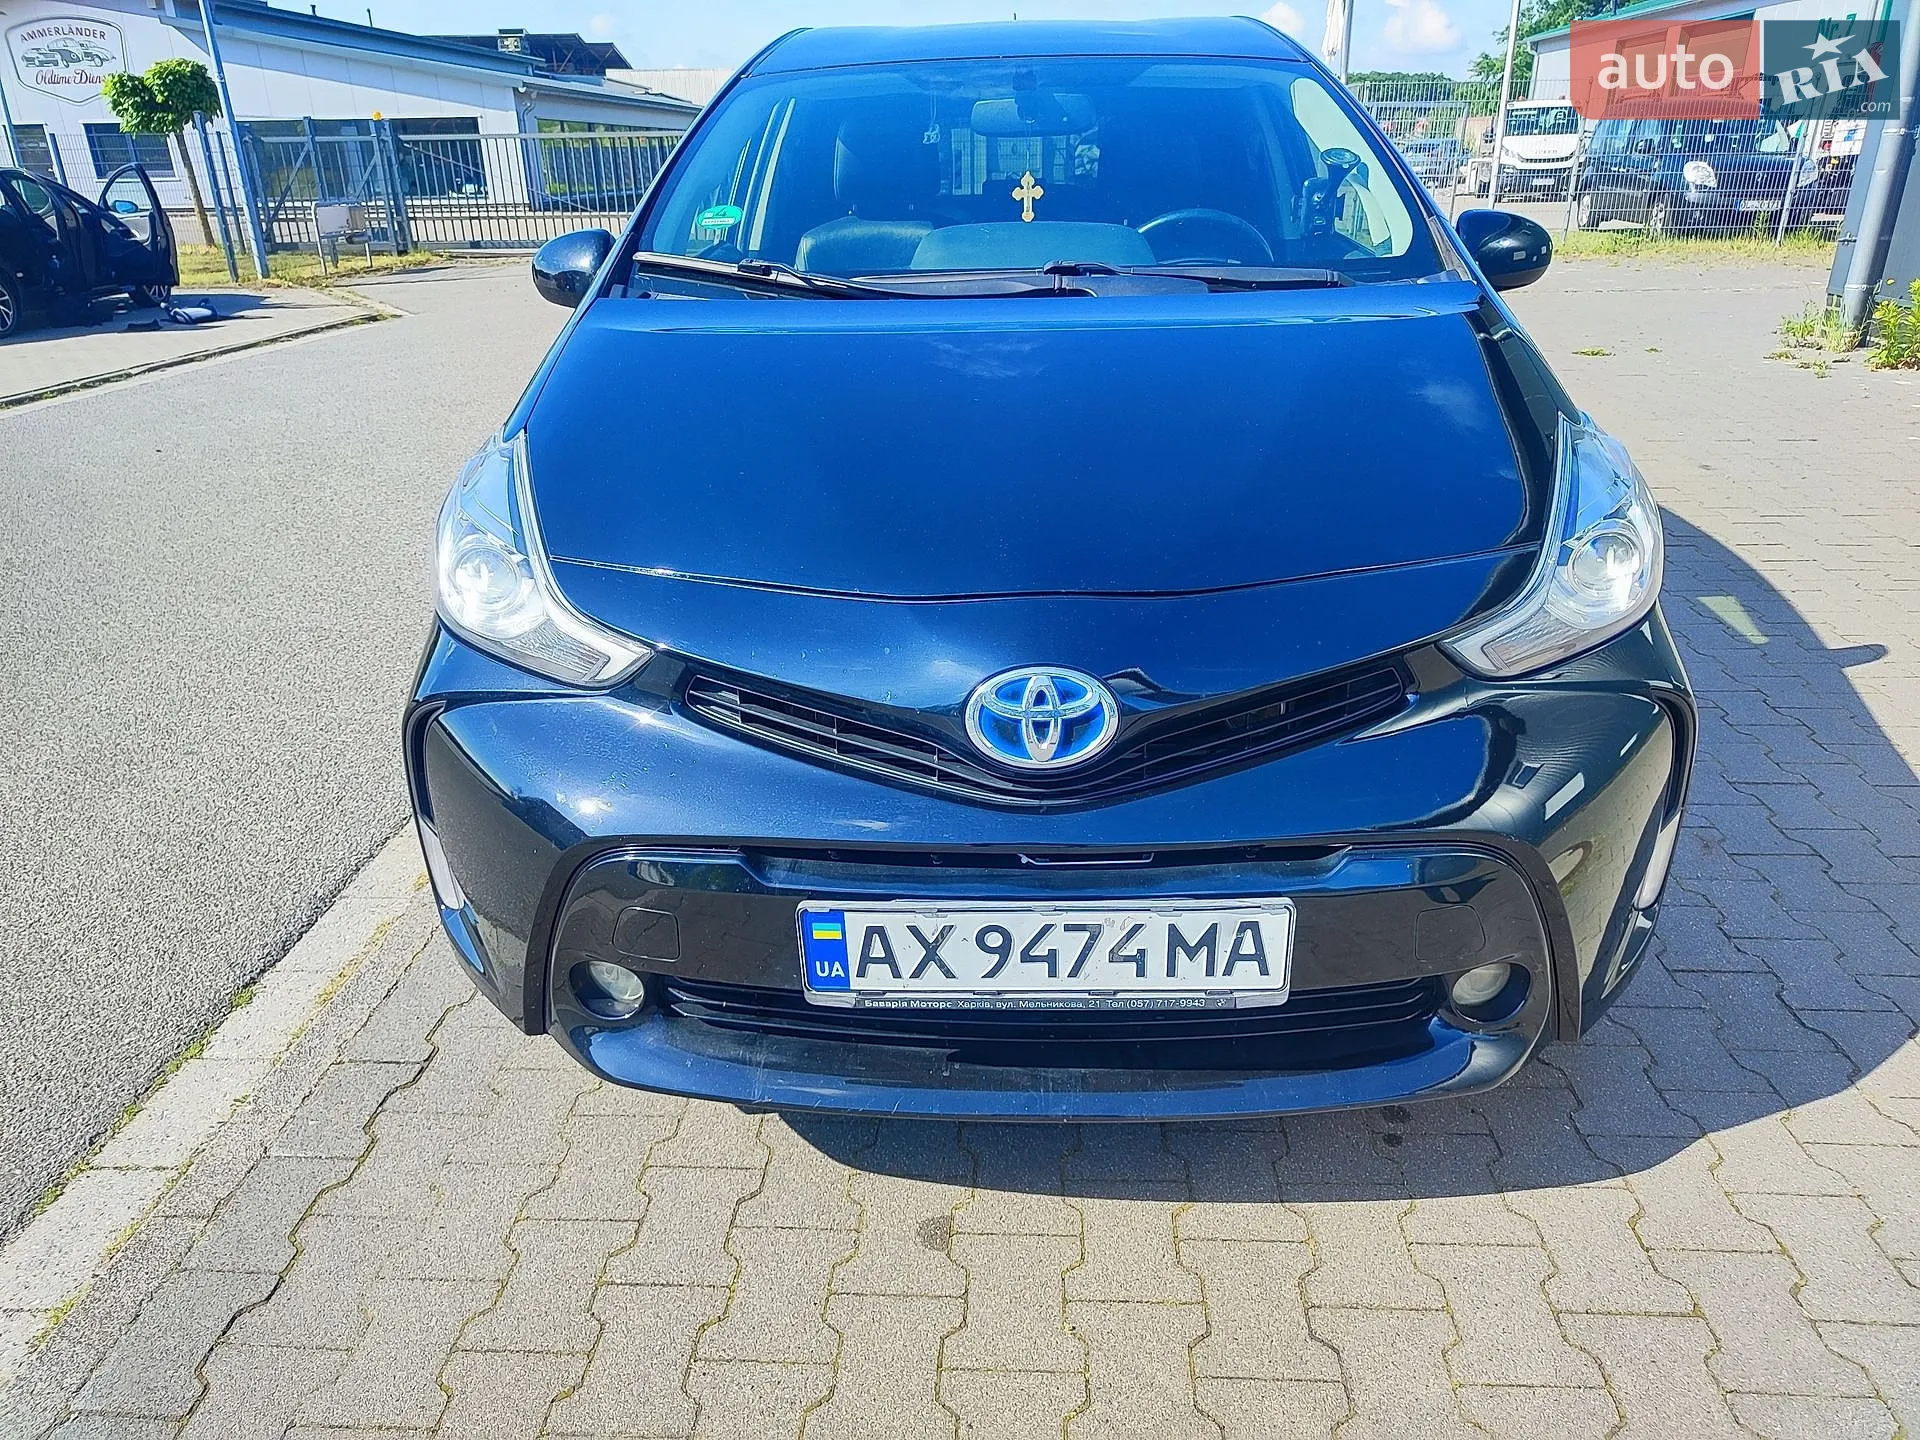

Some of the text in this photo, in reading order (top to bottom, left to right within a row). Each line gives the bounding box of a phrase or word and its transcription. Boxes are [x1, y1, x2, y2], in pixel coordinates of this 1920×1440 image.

[20, 24, 107, 43] AMMERLÄNDER
[74, 69, 103, 85] Dien
[856, 922, 1270, 979] AX 9474 MA
[815, 961, 845, 978] UA
[865, 999, 908, 1009] Баварія
[910, 999, 952, 1009] Моторс
[957, 999, 994, 1009] Харків,
[996, 1000, 1016, 1010] вул.
[1019, 999, 1086, 1009] Мельникова,
[1088, 999, 1100, 1008] 21
[1156, 999, 1205, 1008] 717-9943
